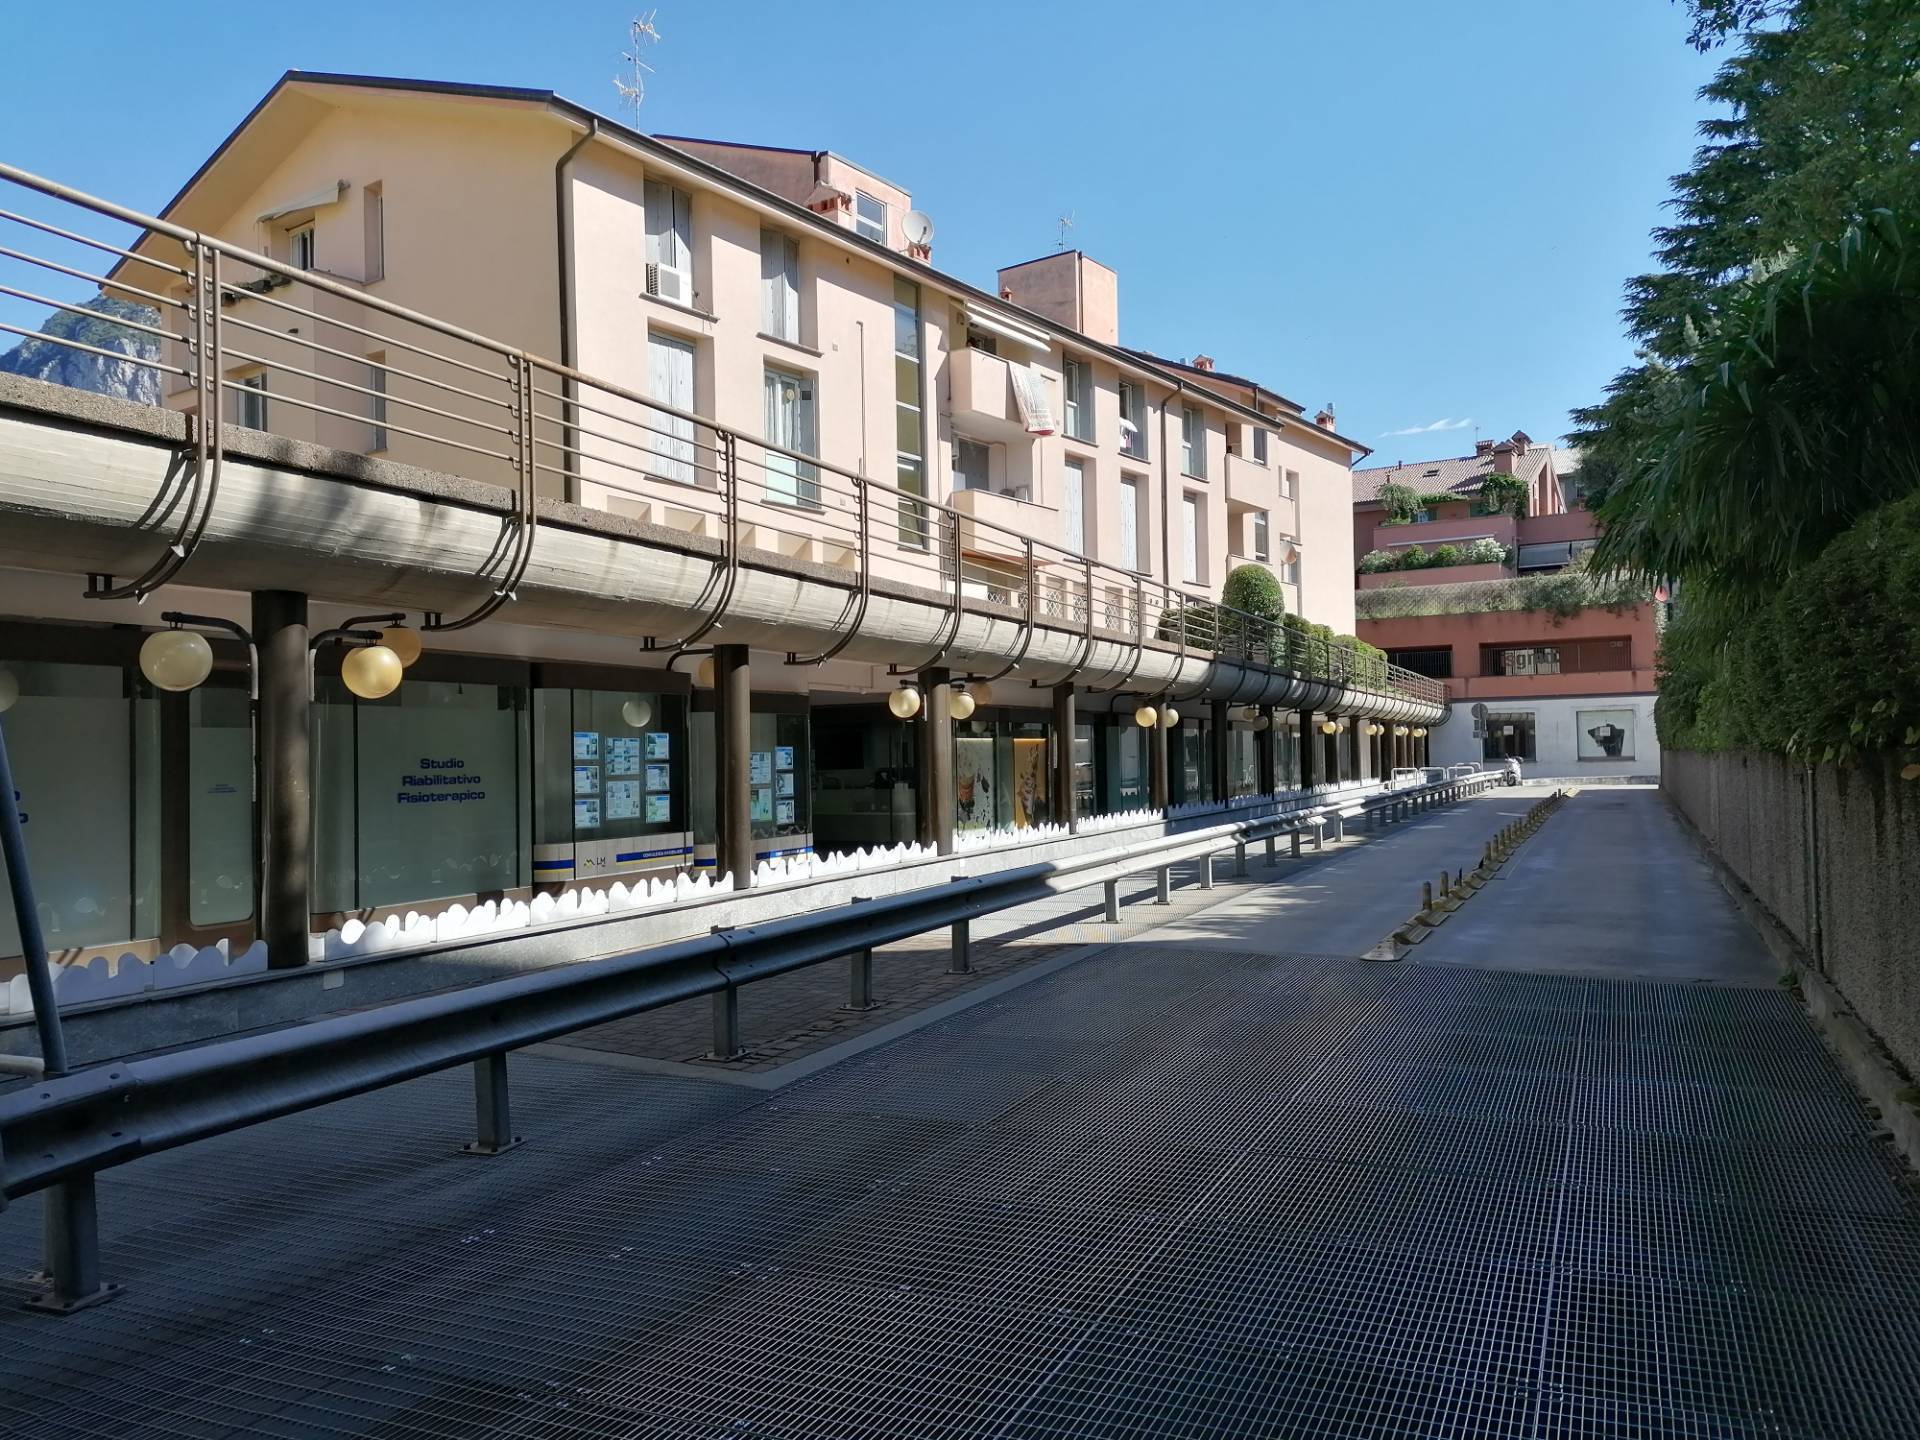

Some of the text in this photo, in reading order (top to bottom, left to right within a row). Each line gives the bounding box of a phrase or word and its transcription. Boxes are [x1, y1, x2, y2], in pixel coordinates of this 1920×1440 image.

[420, 758, 465, 769] Studio
[402, 774, 481, 787] Riabilitativo
[397, 790, 486, 804] Fisioterapico
